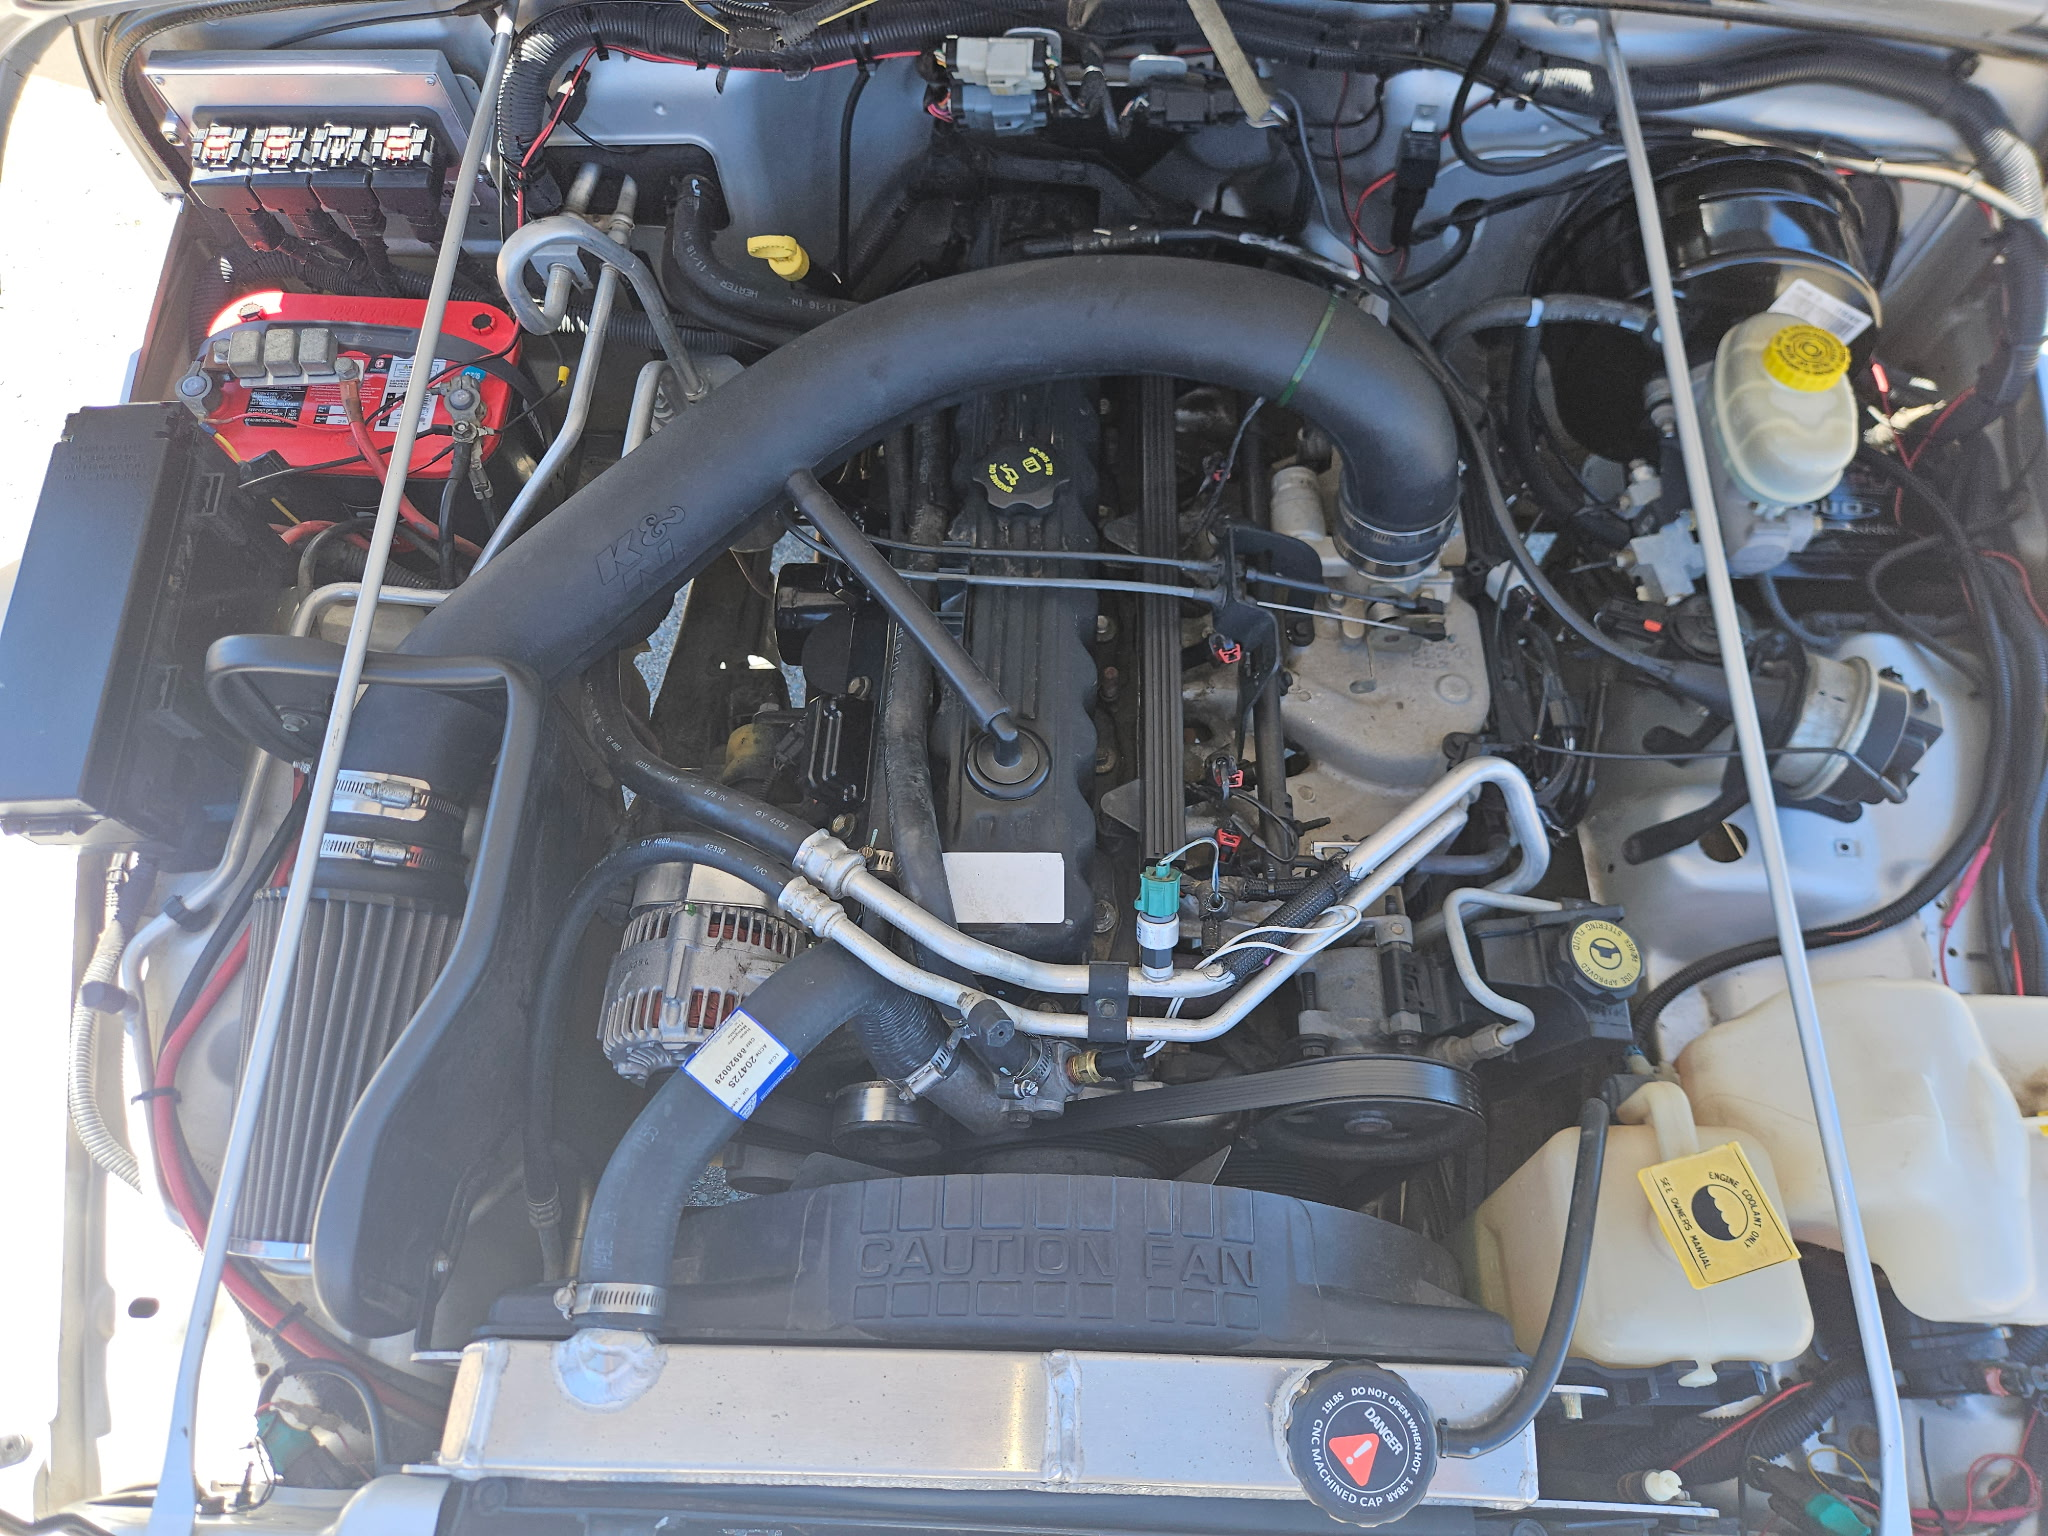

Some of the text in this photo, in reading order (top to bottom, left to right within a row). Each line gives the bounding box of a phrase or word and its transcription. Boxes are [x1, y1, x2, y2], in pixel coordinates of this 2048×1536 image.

[719, 279, 759, 299] HEATER
[1572, 928, 1586, 951] FLUID
[1585, 921, 1623, 937] STEERING
[1580, 962, 1618, 986] APPROVED
[714, 1047, 748, 1085] 88920029
[728, 1055, 757, 1089] 20472S
[1660, 1177, 1712, 1270] SEE OWNERS MANUAL
[1708, 1171, 1762, 1248] ENGINE COOLANT ONLY
[856, 1233, 1259, 1288] CAUTION FAN
[1321, 1391, 1345, 1415] 19LBS
[1351, 1386, 1422, 1475] DO NOT OPEN WHEN HOT
[1364, 1406, 1404, 1456] DANGER
[1311, 1419, 1383, 1507] CNC MACHINED CAP
[1386, 1476, 1414, 1503] 1.3BAR
